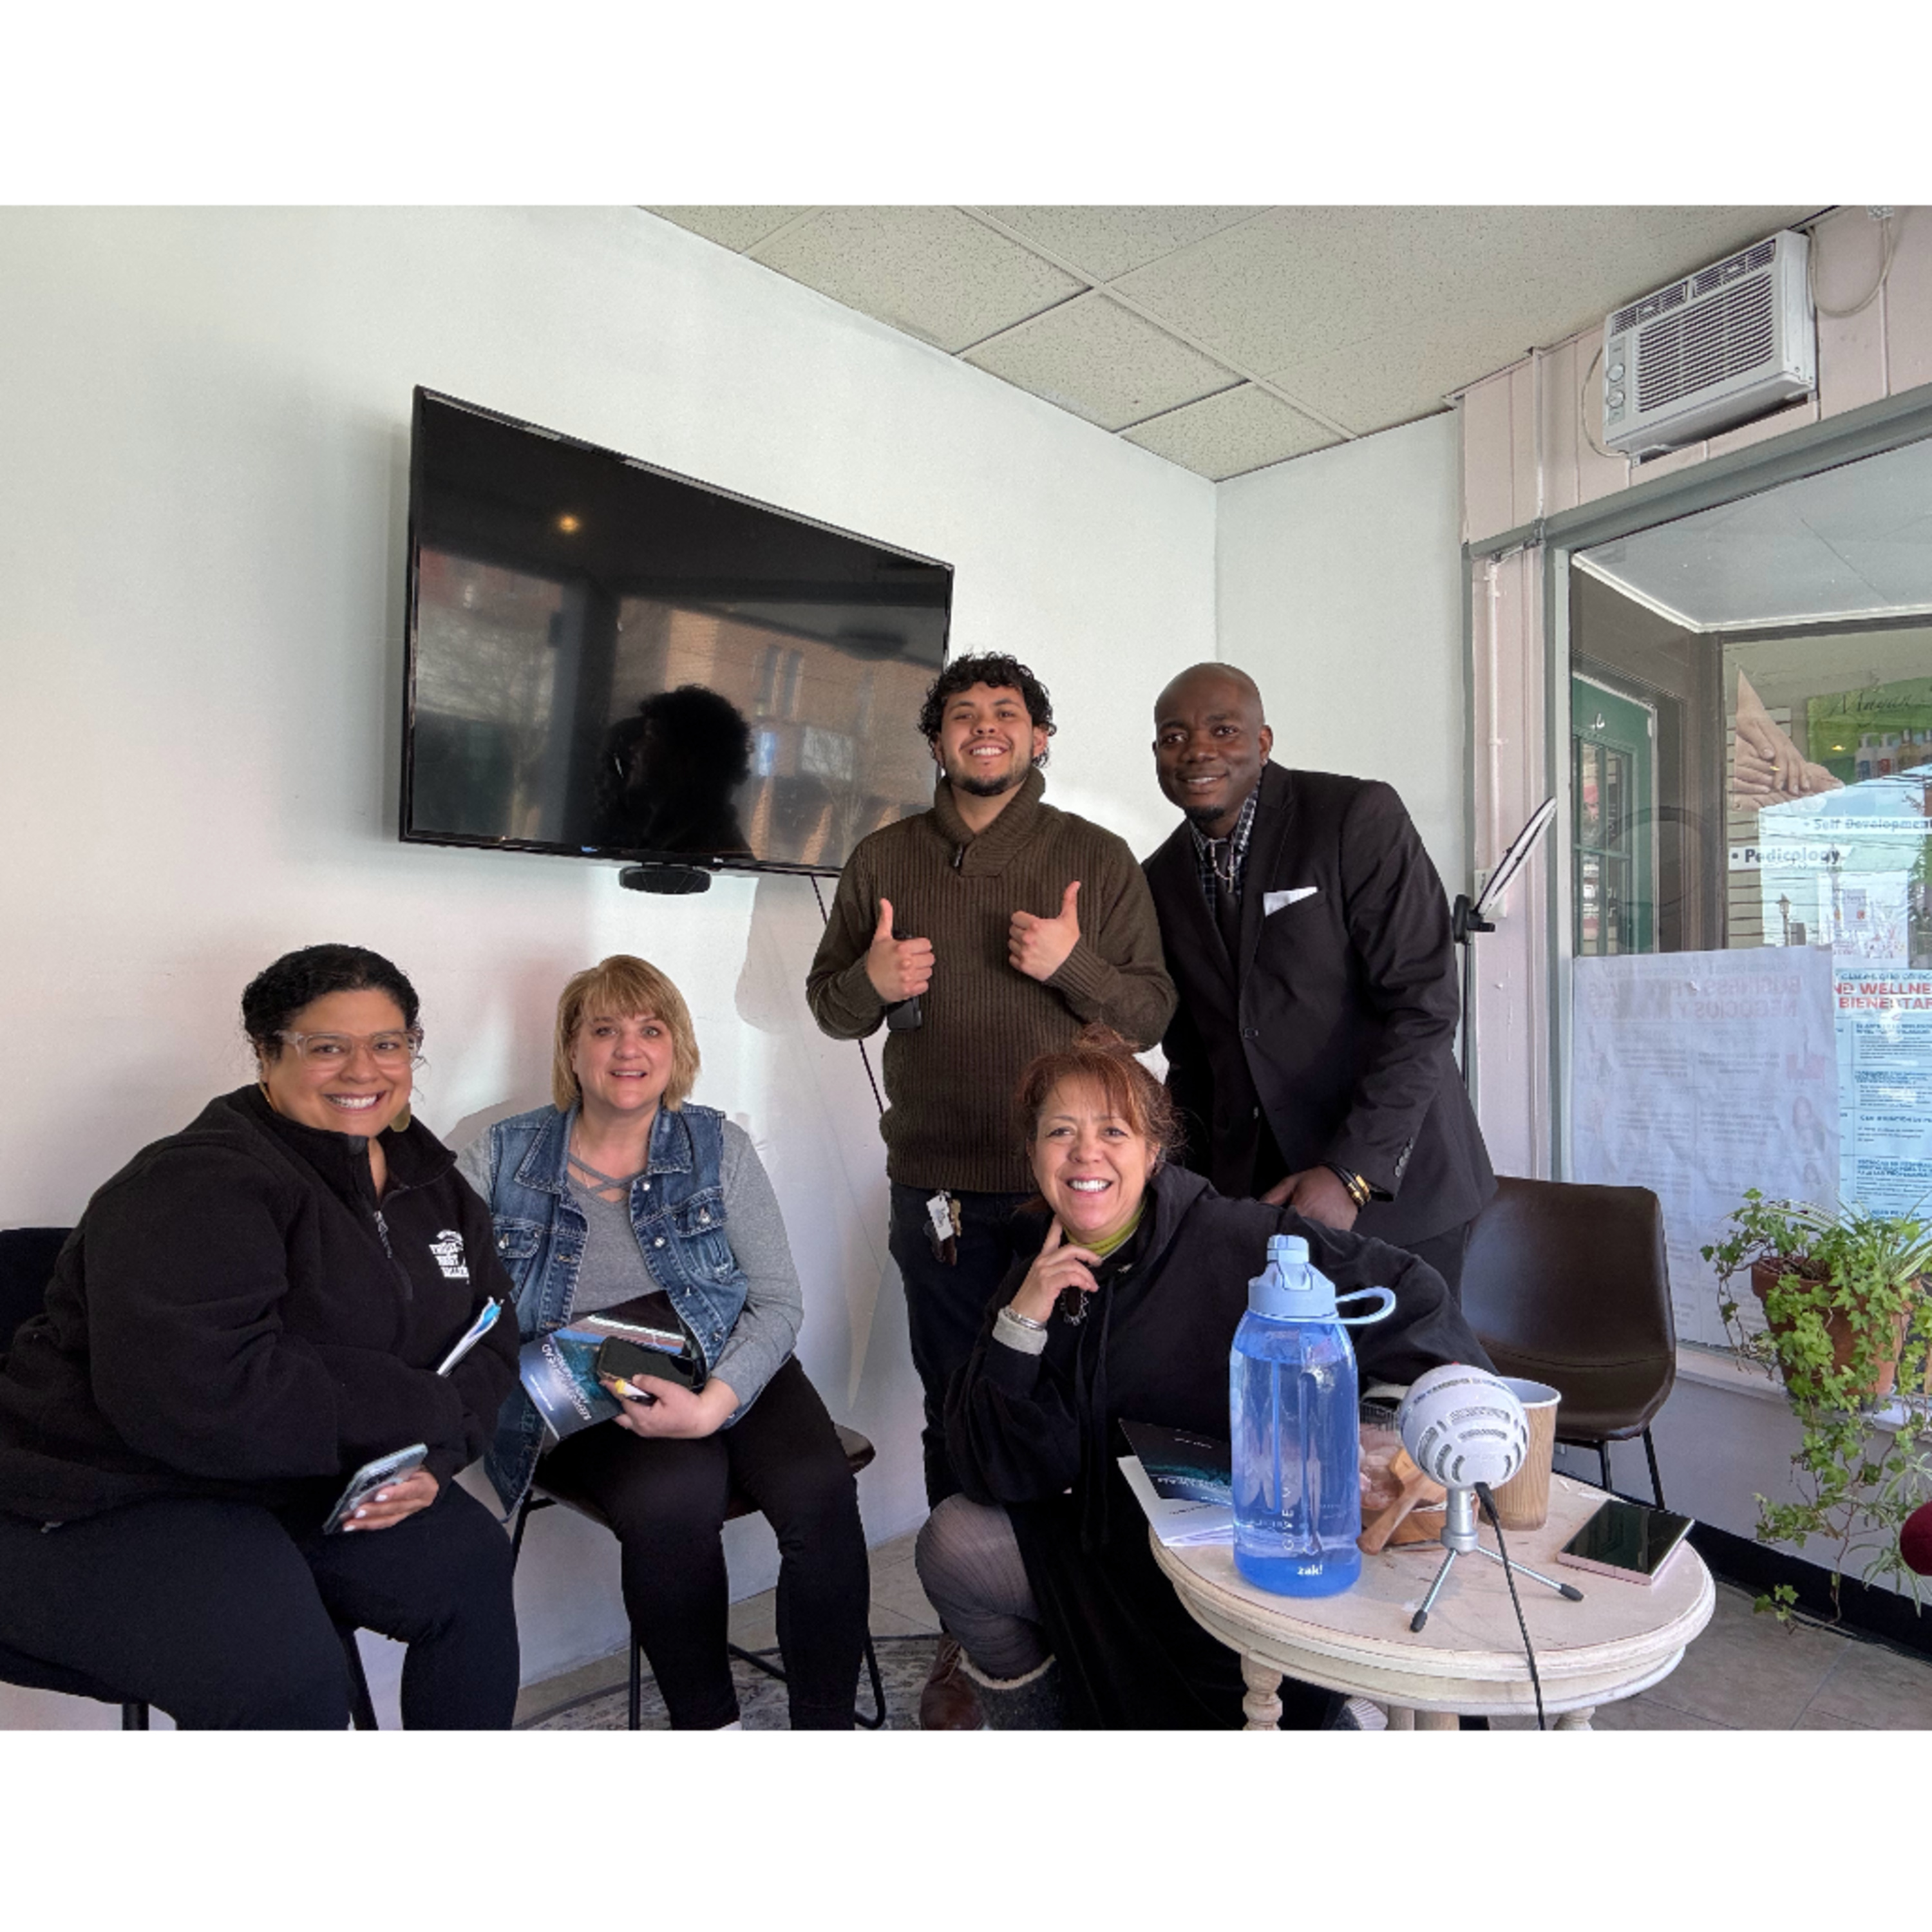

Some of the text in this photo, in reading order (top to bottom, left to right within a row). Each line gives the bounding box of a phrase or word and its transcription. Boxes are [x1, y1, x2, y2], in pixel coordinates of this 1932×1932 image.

[1814, 818, 1841, 830] Self
[1744, 846, 1840, 865] Pedicology
[1859, 982, 1931, 995] WELLNE
[1296, 1563, 1323, 1575] zak!
